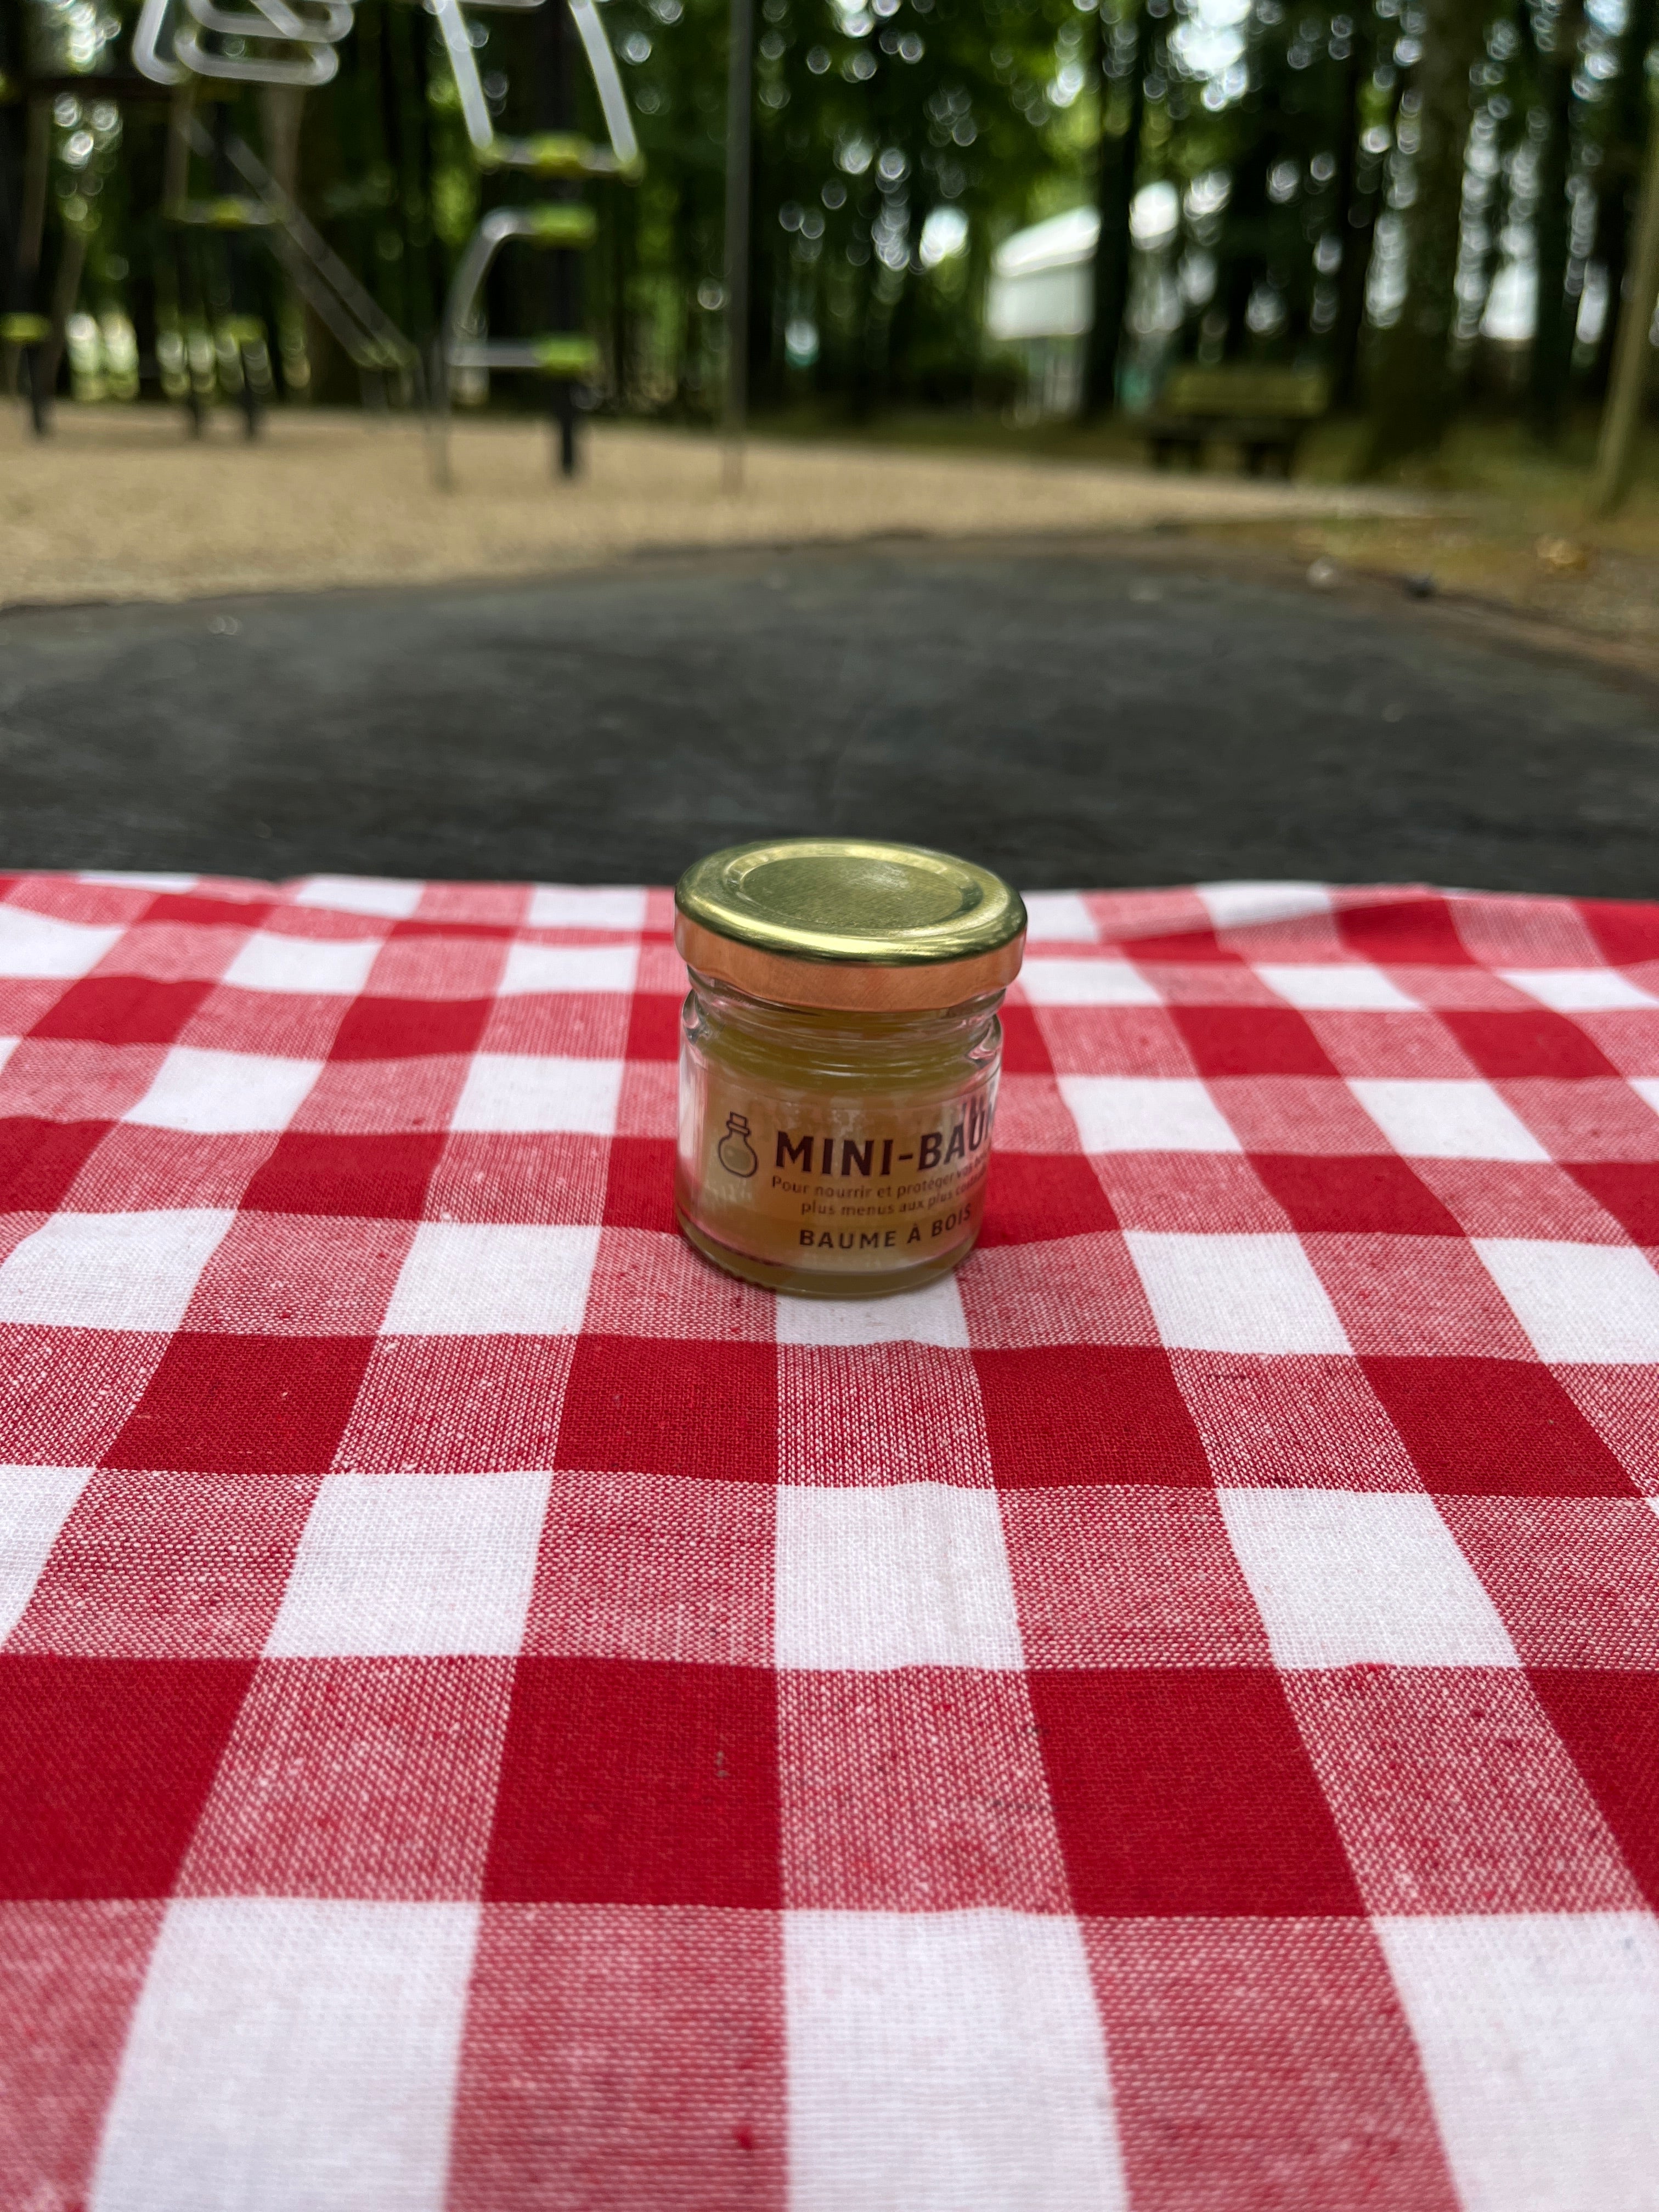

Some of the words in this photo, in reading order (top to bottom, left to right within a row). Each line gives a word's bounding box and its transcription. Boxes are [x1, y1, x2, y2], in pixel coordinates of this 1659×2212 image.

[777, 1109, 989, 1176] MINI-BAU
[772, 1175, 809, 1194] Pour
[816, 1185, 872, 1199] nourrir
[878, 1186, 891, 1198] et
[802, 1200, 834, 1215] plus
[842, 1204, 894, 1216] menus
[899, 1200, 923, 1212] aux
[927, 1190, 953, 1210] plus
[800, 1229, 896, 1249] BAUME
[907, 1222, 921, 1244] À
[931, 1203, 971, 1238] BOIS
